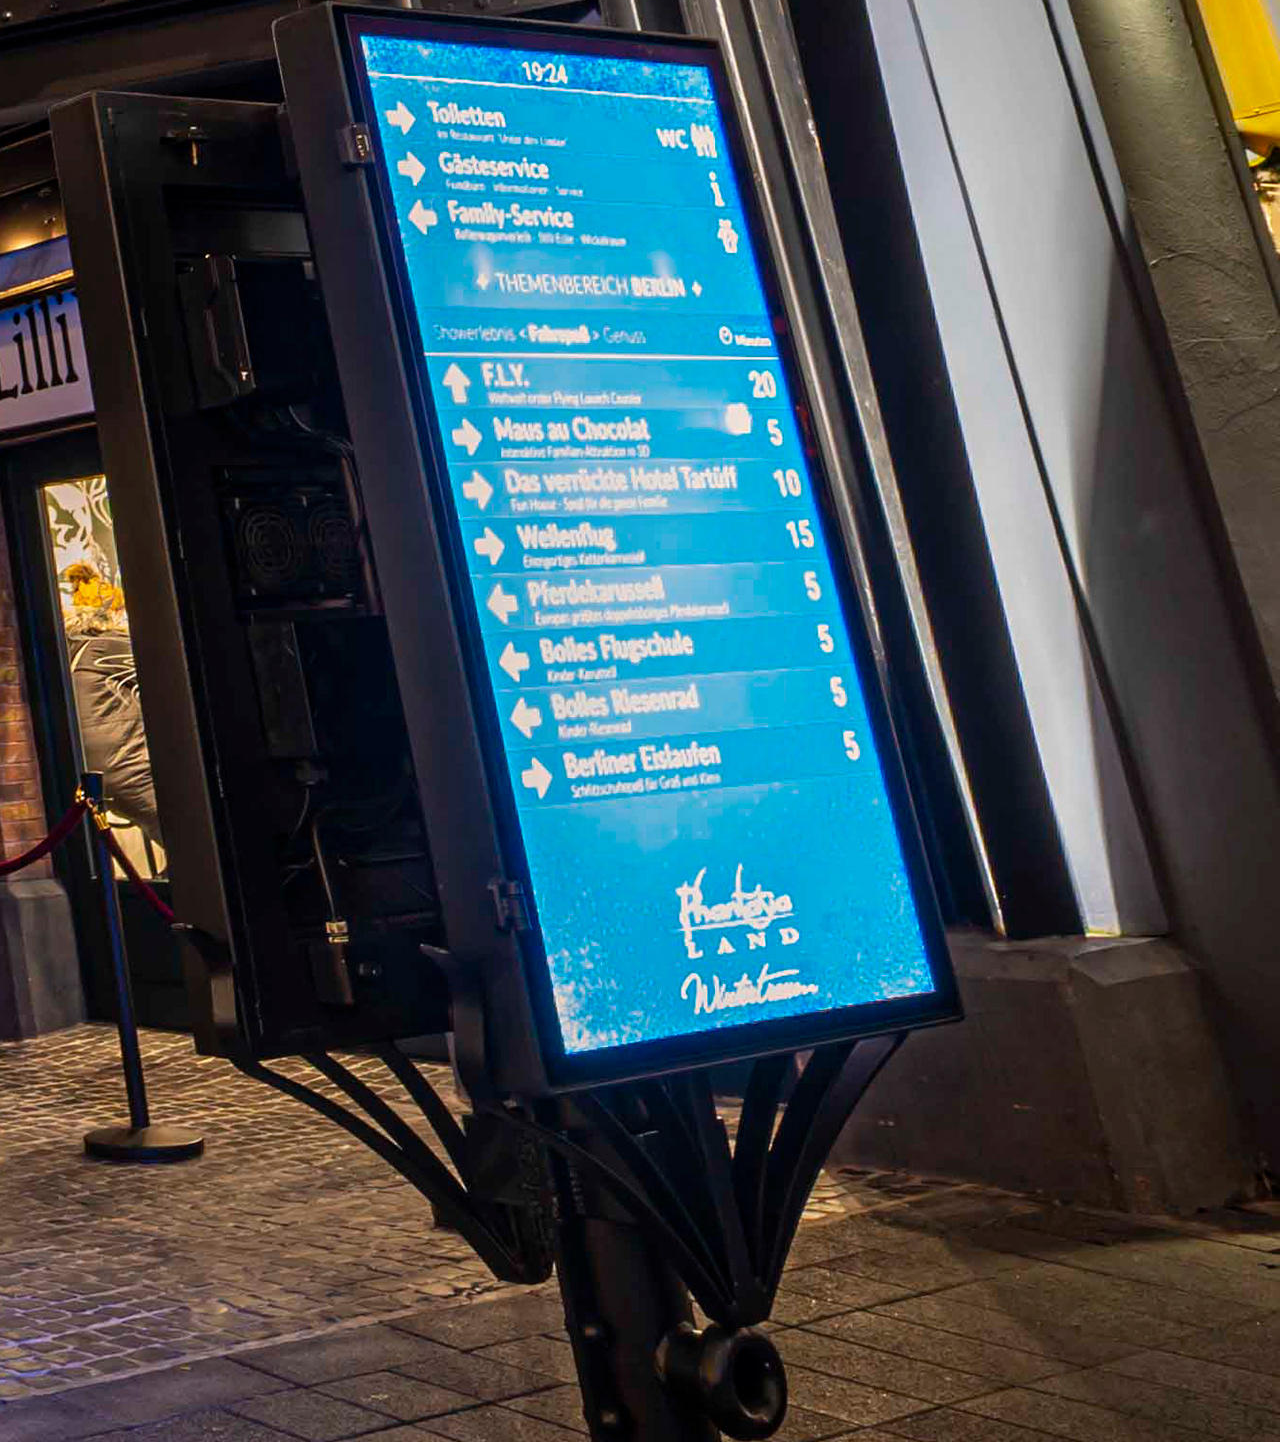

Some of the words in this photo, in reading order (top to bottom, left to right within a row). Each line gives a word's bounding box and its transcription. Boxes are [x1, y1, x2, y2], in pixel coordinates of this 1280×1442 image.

[522, 60, 568, 85] 19:24
[427, 100, 507, 128] Toiletten
[656, 127, 689, 150] WC
[438, 151, 550, 180] Gästeservice
[447, 199, 575, 230] Family-Service
[495, 272, 630, 296] THEMENBEREICH
[481, 362, 531, 388] F.L.Y.
[748, 369, 777, 399] 20
[493, 416, 545, 442] Maus
[547, 421, 570, 442] au
[571, 415, 652, 442] Chocolat
[767, 418, 783, 446] 5
[504, 468, 541, 494] Das
[543, 467, 628, 493] verrückte
[630, 465, 679, 492] Hotel
[773, 468, 802, 498] 10
[516, 522, 616, 552] Wellenflug
[786, 518, 815, 550] 15
[527, 574, 666, 607] Pferdekarussell
[803, 570, 822, 602] 5
[539, 634, 598, 664] Bolles
[599, 628, 695, 664] Flugschule
[817, 623, 835, 653] 5
[550, 691, 609, 720] Bolles
[610, 682, 700, 715] Riesenrad
[829, 676, 848, 708] 5
[562, 748, 637, 779] Berliner
[638, 740, 722, 772] Eislaufen
[843, 730, 861, 762] 5
[687, 927, 800, 960] LAND
